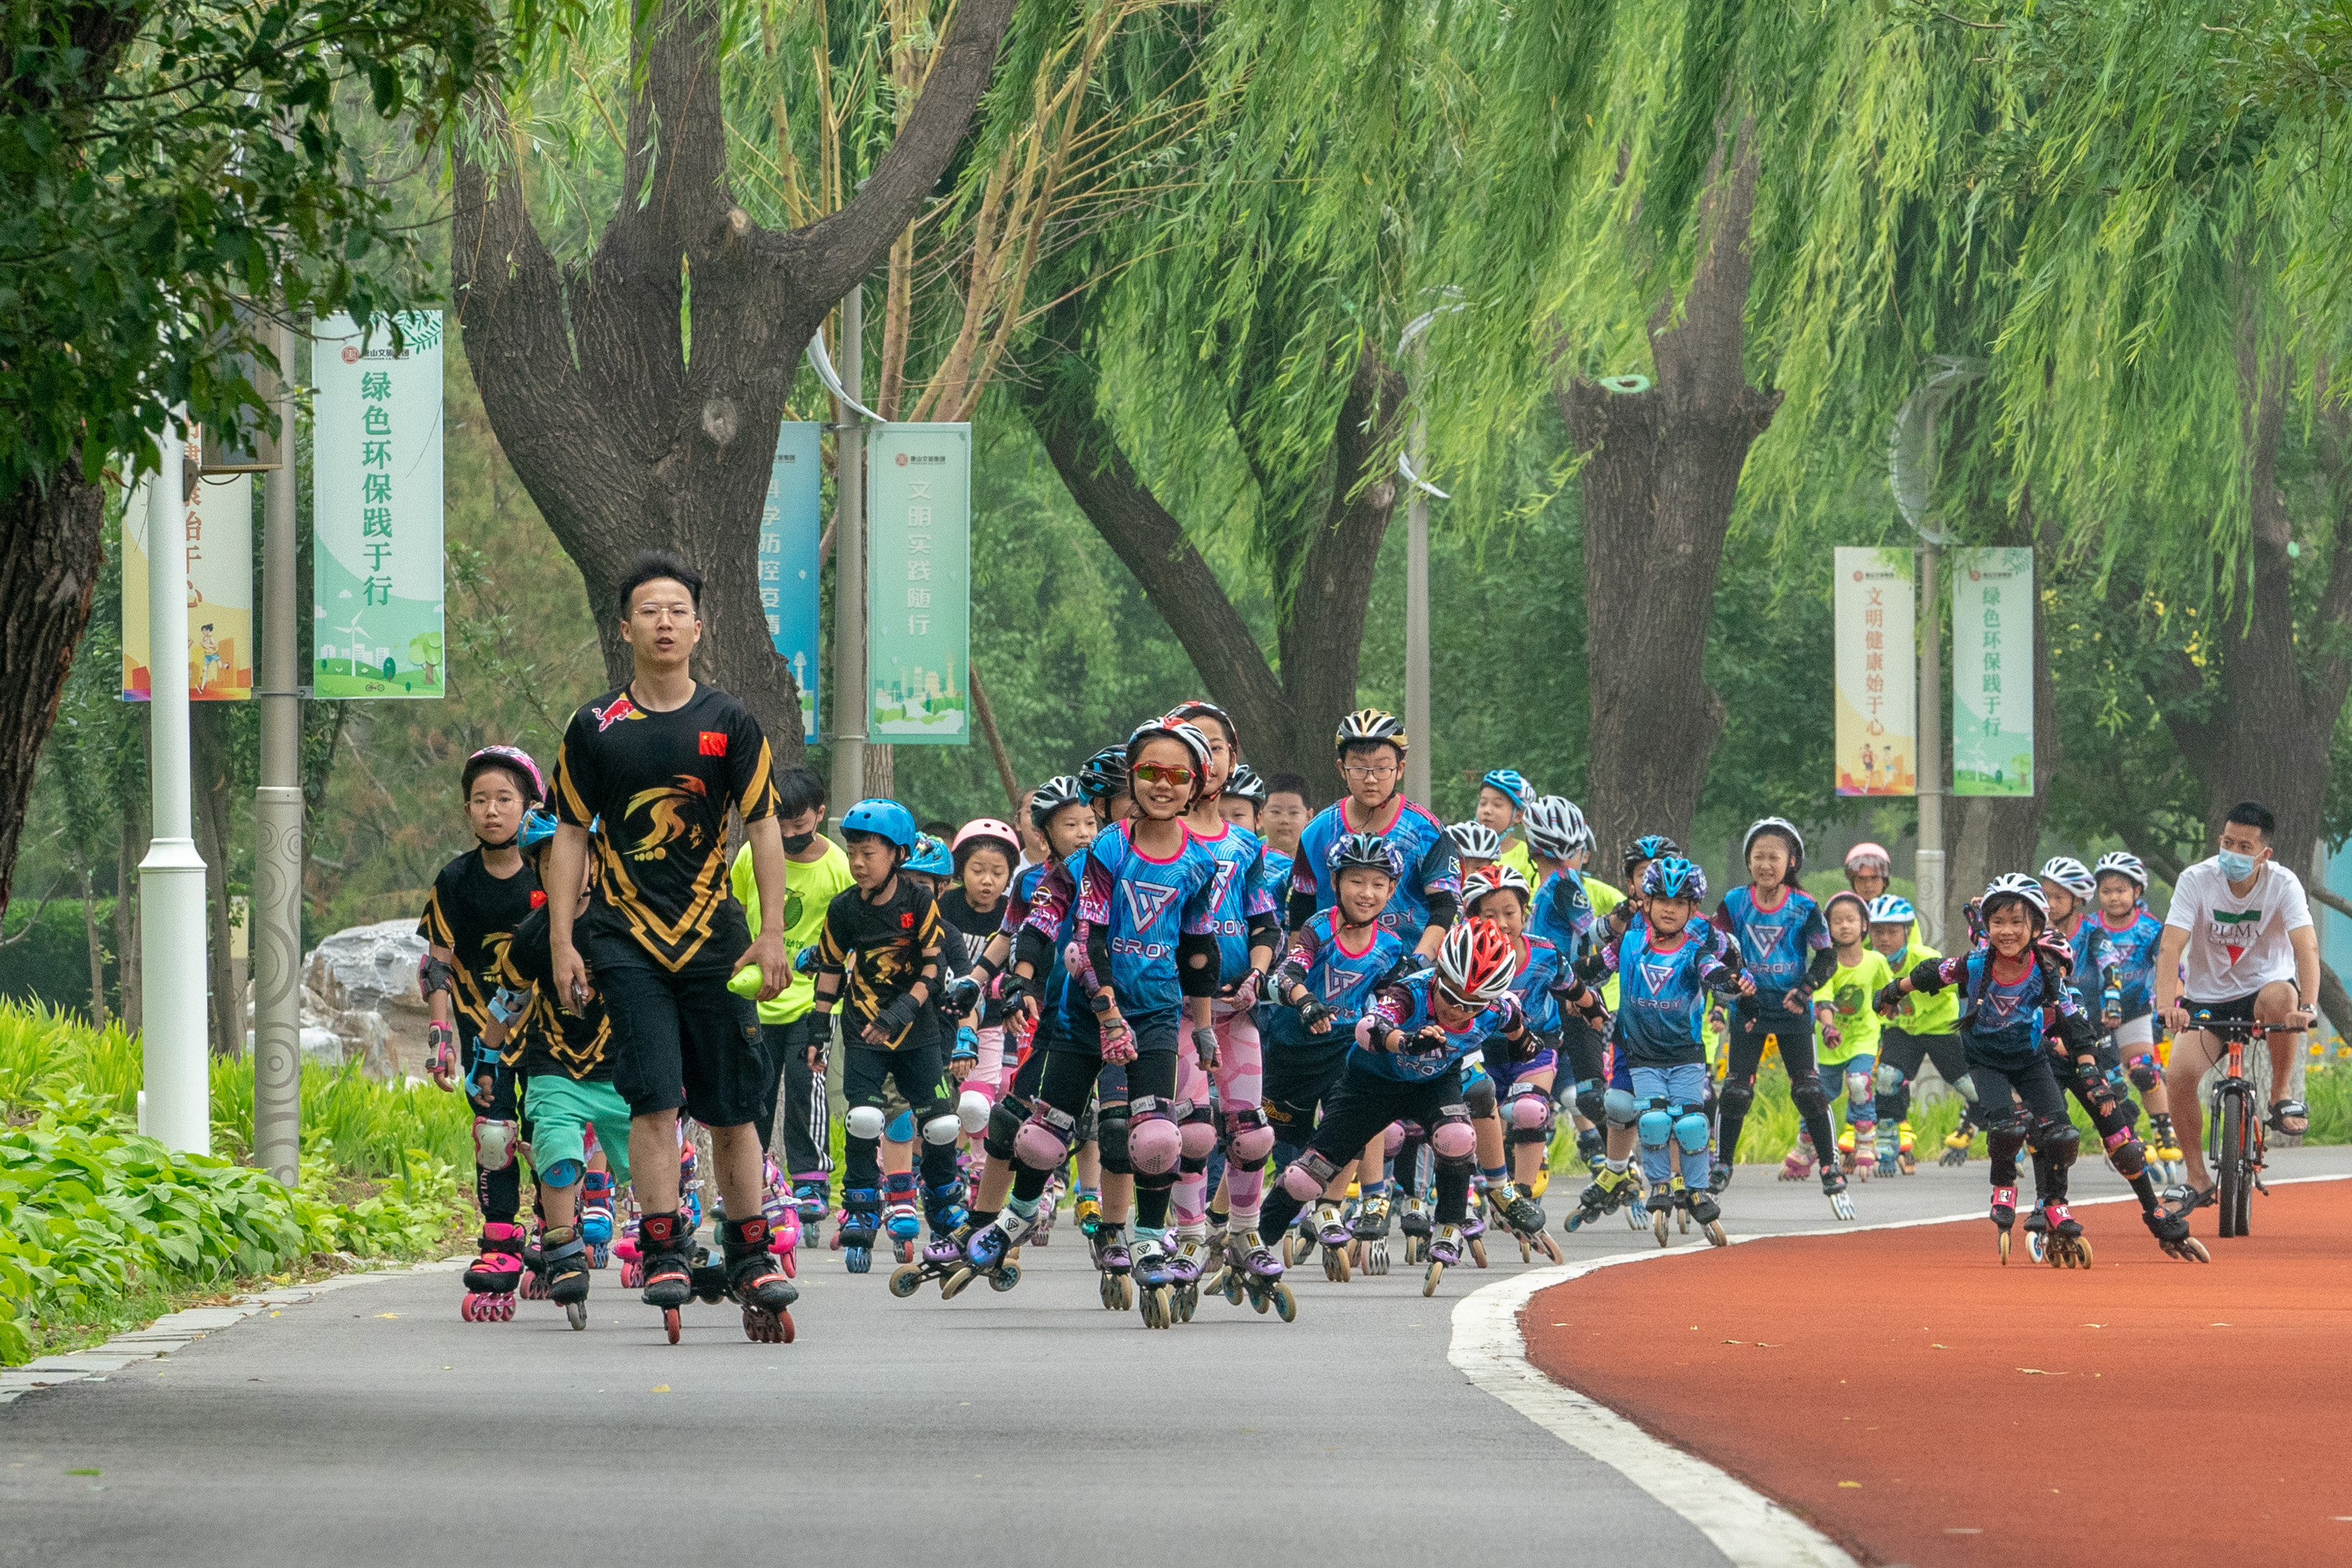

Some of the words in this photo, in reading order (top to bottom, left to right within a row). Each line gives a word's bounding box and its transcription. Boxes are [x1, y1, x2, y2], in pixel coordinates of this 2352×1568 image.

[361, 371, 393, 606] 绿色环保践于行
[907, 481, 932, 635] 文明实践随行
[1864, 587, 1885, 737] 文明健康始于心
[1981, 586, 2002, 737] 绿色环保践于行
[1631, 994, 1683, 1010] LEROY
